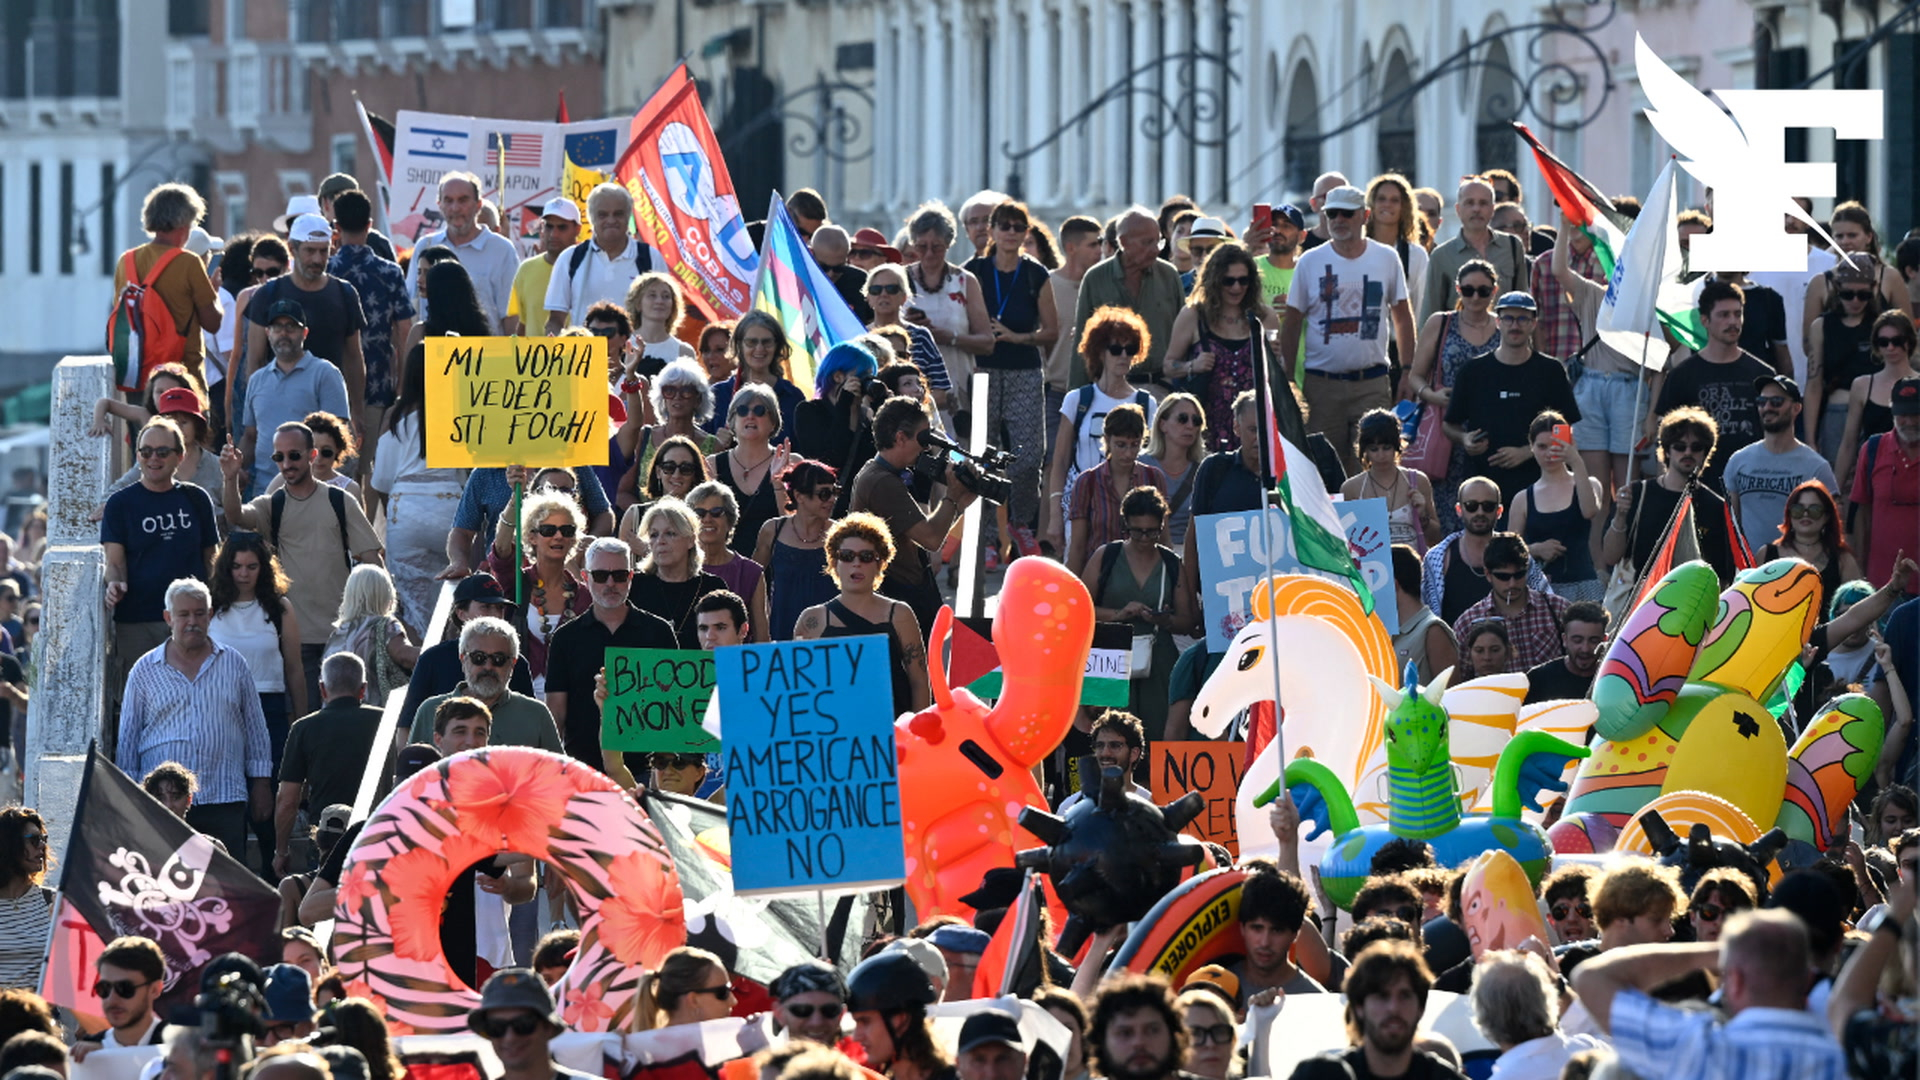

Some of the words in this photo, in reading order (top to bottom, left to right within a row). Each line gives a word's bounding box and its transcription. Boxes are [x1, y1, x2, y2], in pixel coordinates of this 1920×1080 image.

[626, 177, 669, 246] REDDITO
[686, 226, 744, 304] COBAS
[443, 346, 484, 376] MI
[515, 343, 592, 378] VORIA
[470, 379, 552, 410] VEDER
[1698, 386, 1731, 401] ORA
[450, 414, 486, 445] STI
[508, 410, 598, 445] FOGHI
[142, 508, 191, 533] out
[613, 655, 718, 696] BLOOD
[741, 643, 864, 692] PARTY
[615, 695, 710, 735] MONE
[760, 690, 839, 738] YES
[725, 734, 895, 789] AMERICAN
[1163, 749, 1215, 793] NO
[729, 781, 900, 836] ARROGANCE
[786, 832, 845, 879] NO
[1160, 898, 1231, 977] EXPLORER
